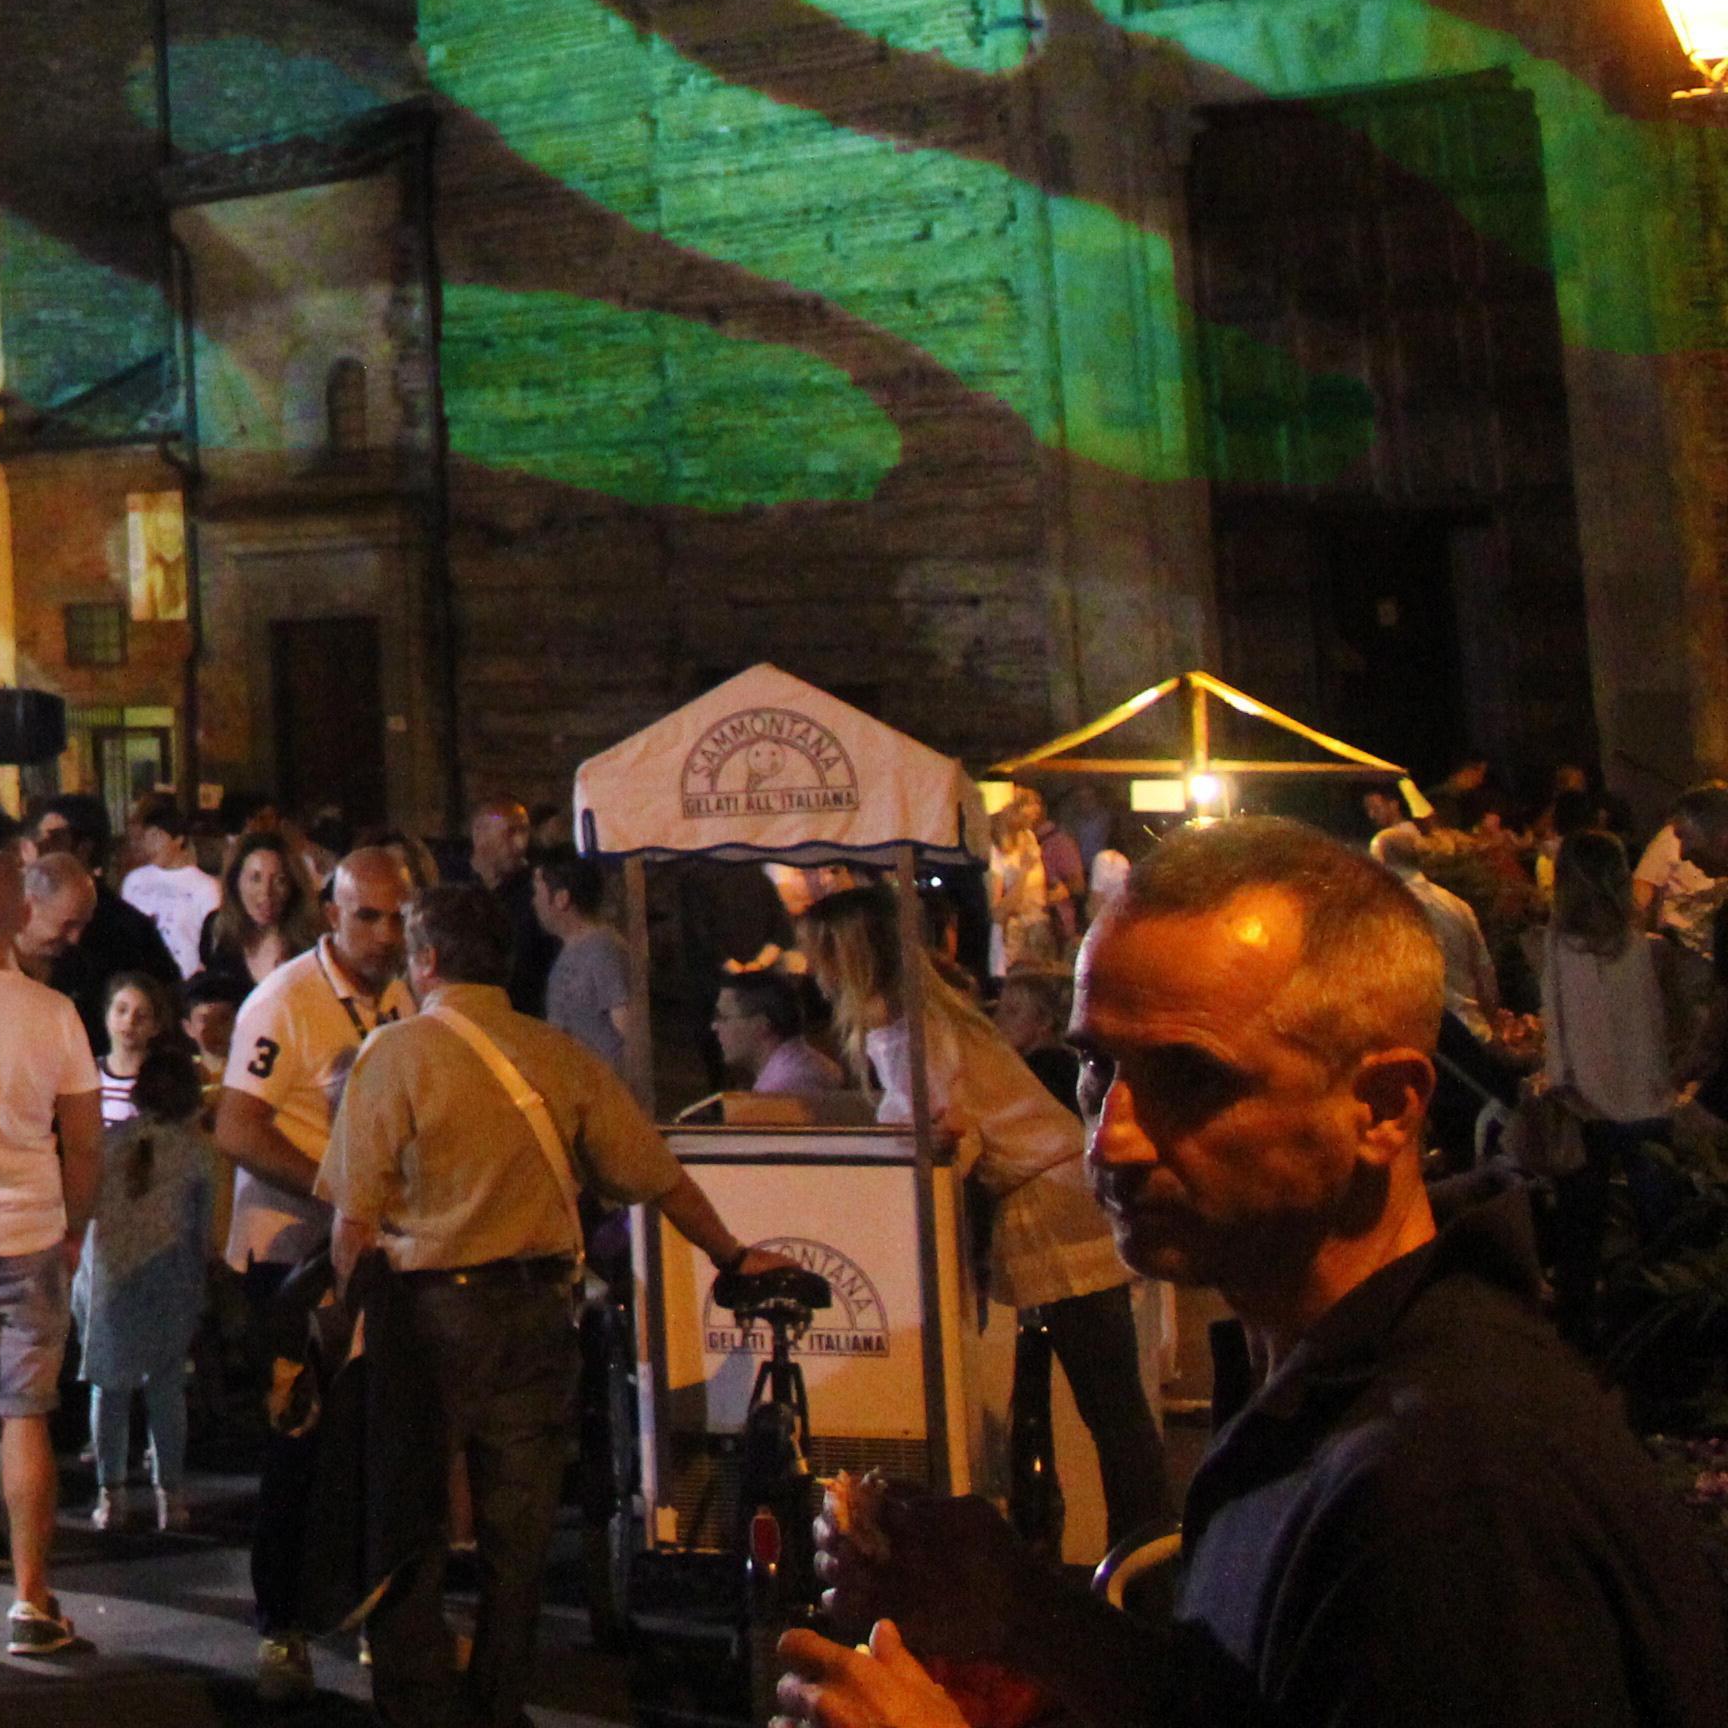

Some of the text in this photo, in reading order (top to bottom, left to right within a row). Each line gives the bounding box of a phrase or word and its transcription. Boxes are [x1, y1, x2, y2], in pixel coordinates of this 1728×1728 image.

[691, 715, 843, 779] SAMMONTANA
[686, 797, 738, 814] GELATI
[248, 1036, 280, 1078] 3
[708, 1332, 765, 1350] GELTI
